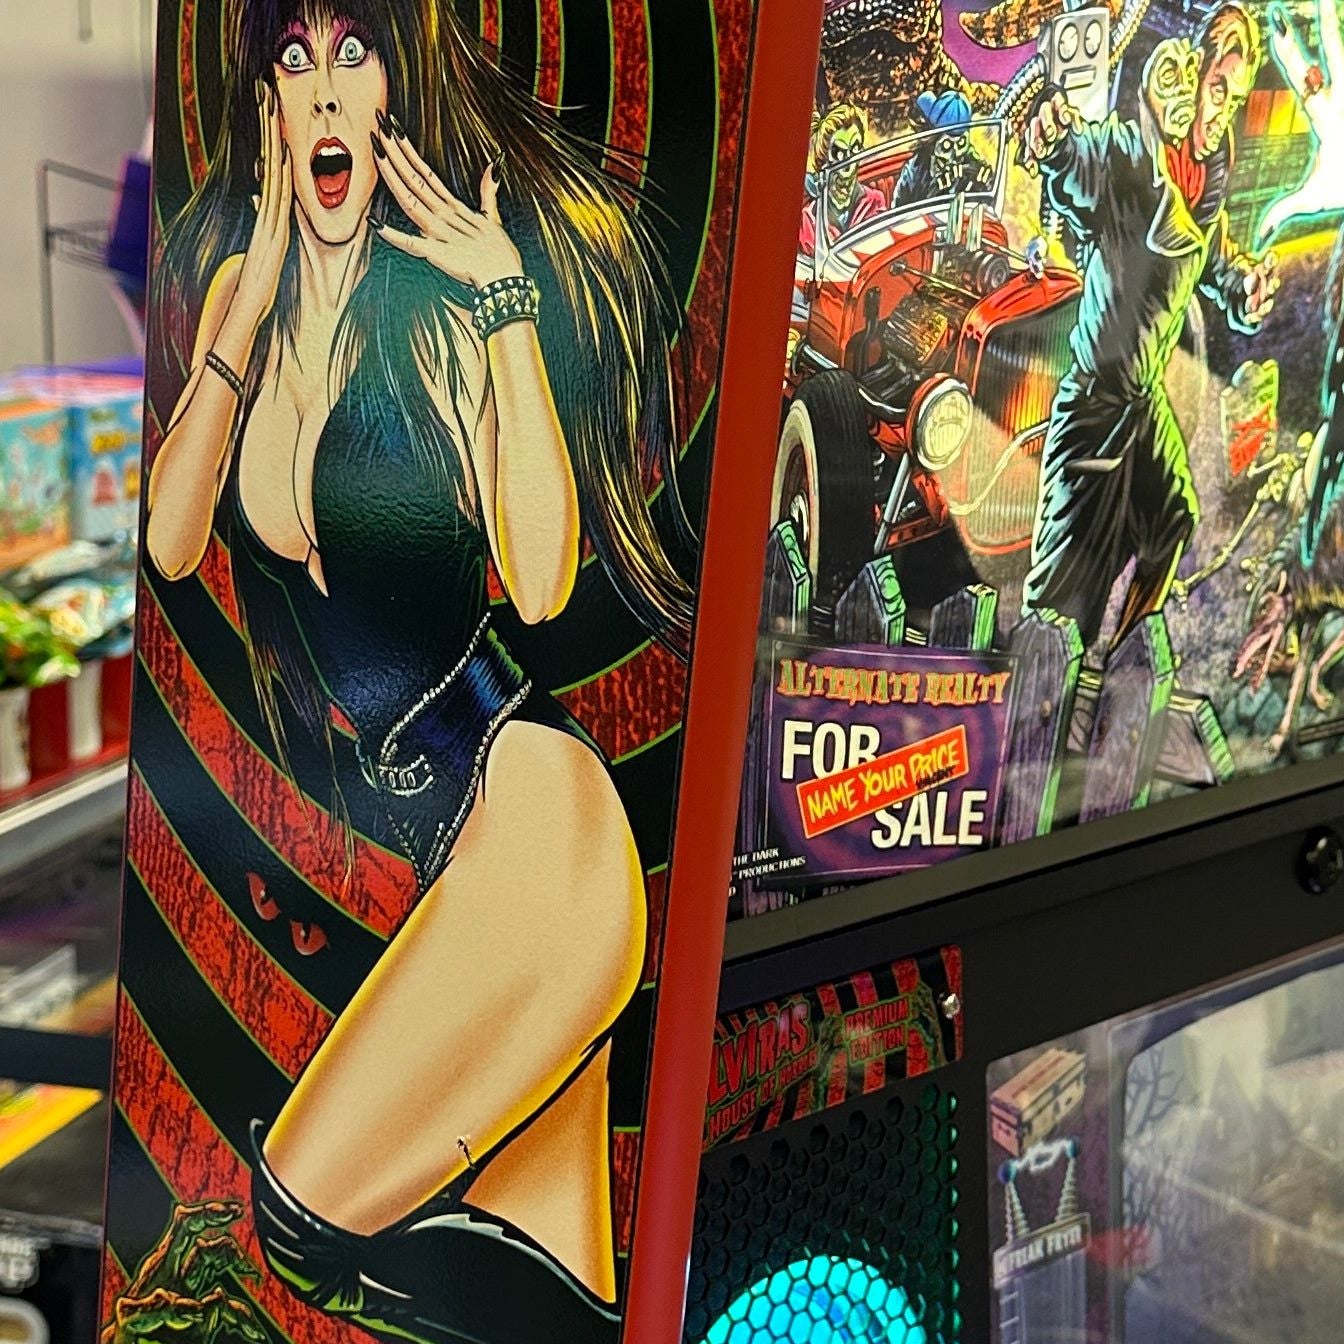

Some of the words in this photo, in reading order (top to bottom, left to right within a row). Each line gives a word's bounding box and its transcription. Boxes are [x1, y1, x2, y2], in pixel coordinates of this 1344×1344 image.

[776, 659, 920, 706] ALTERNATE
[923, 672, 1011, 706] REALTY
[782, 720, 880, 779] FOR
[807, 779, 858, 823] NAME
[859, 765, 908, 803] YOUR
[909, 739, 960, 783] PRICE
[871, 791, 987, 848] SALE
[739, 856, 806, 880] PRODUCTIONS
[752, 848, 779, 862] DARK
[845, 997, 909, 1035] PREMIUM
[707, 1001, 809, 1106] LVIRA'S
[850, 1024, 904, 1061] EDITION
[709, 1089, 755, 1141] HOUSE
